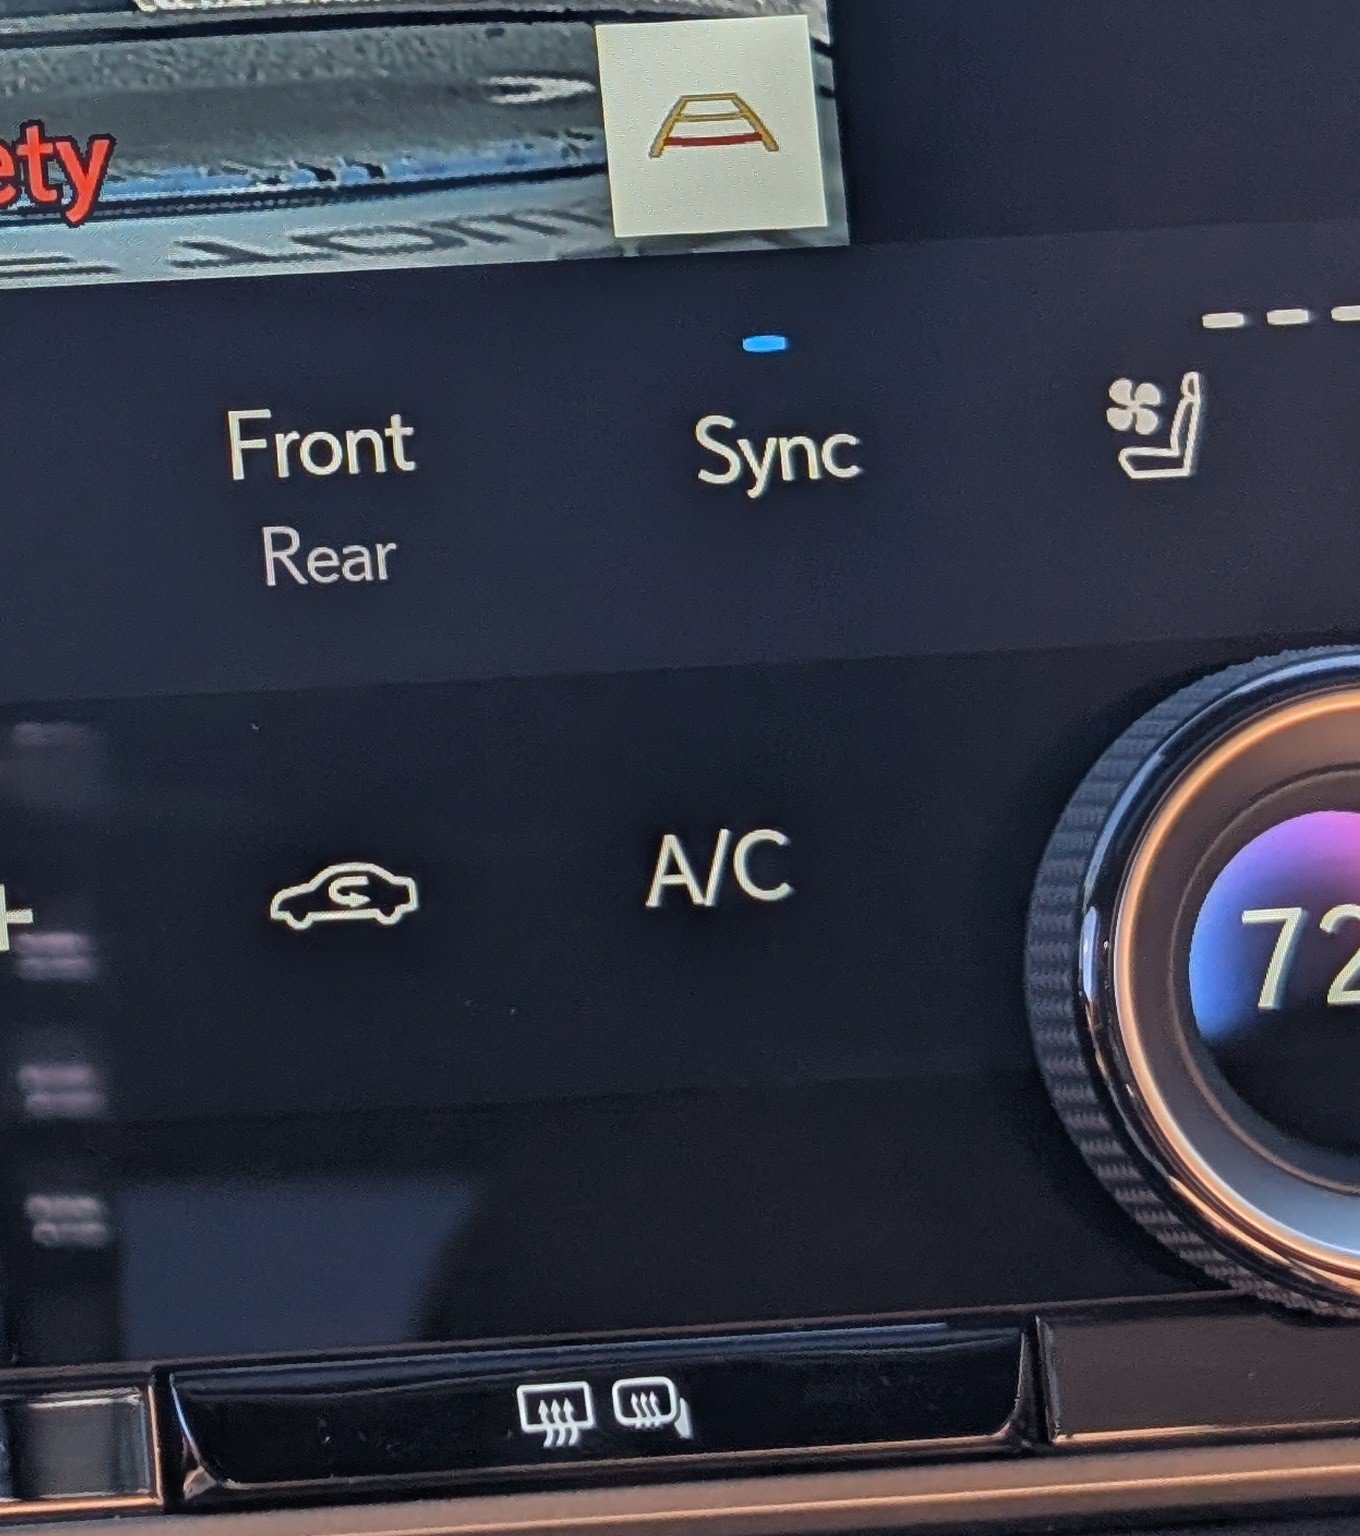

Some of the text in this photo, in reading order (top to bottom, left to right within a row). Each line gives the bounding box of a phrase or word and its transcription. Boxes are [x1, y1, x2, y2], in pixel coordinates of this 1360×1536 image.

[226, 407, 418, 482] Front
[694, 413, 863, 500] Sync
[261, 524, 398, 588] Rear
[644, 827, 793, 909] A/C
